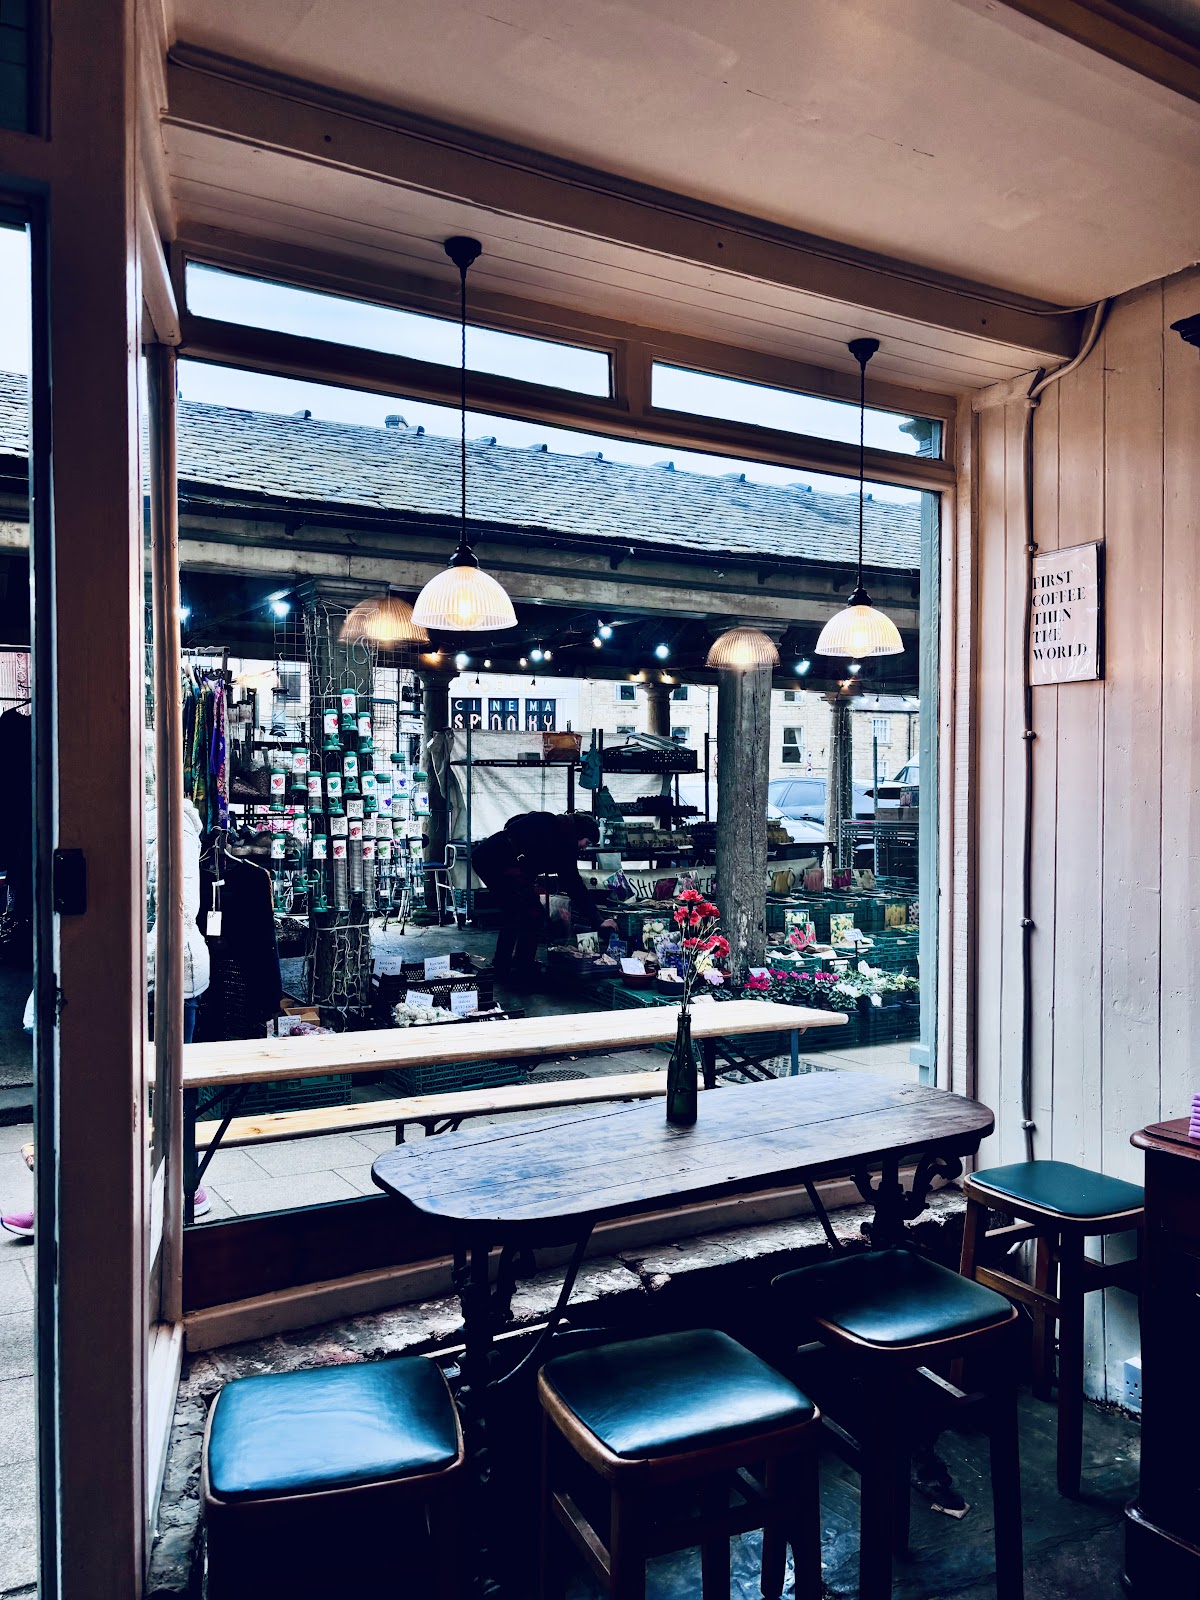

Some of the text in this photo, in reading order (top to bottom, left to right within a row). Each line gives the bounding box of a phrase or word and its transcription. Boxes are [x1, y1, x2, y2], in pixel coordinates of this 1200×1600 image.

[1032, 570, 1074, 590] FIRST
[1032, 586, 1087, 608] COFFEE
[1032, 608, 1072, 626] THEN
[1032, 628, 1062, 644] THE
[1033, 643, 1087, 661] WORLD
[454, 699, 552, 712] CINEMA
[454, 713, 553, 731] SPOOKY
